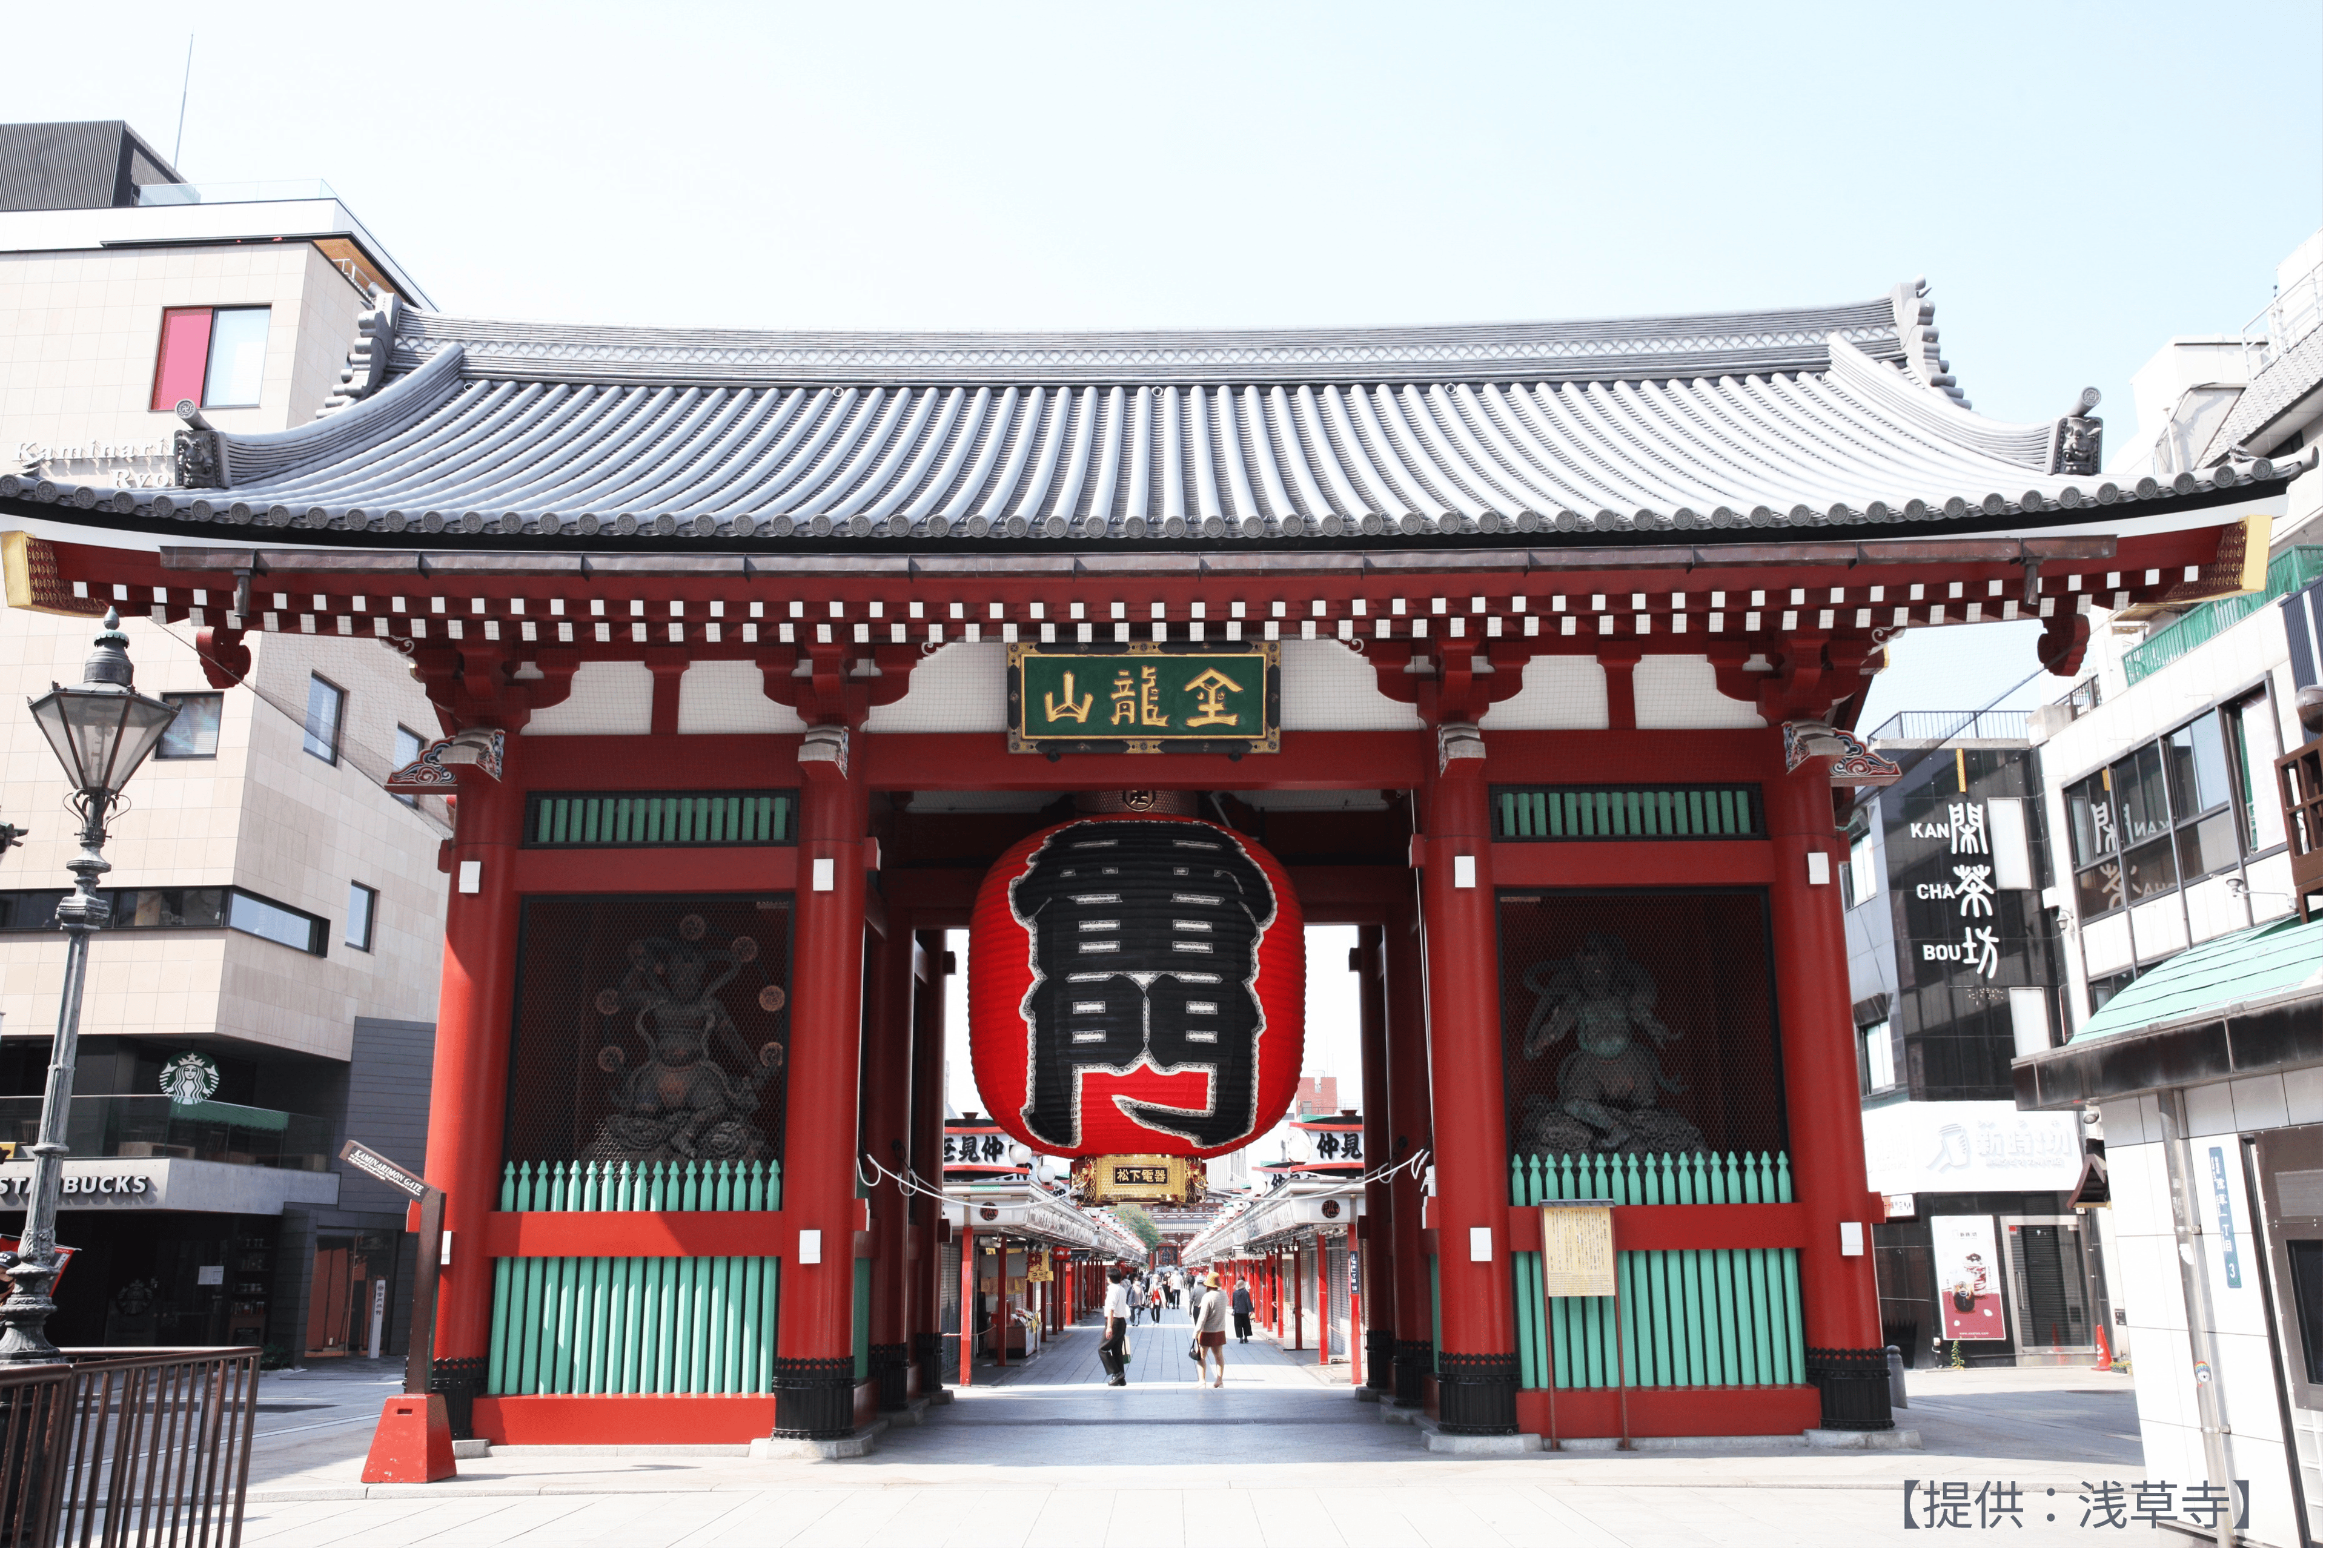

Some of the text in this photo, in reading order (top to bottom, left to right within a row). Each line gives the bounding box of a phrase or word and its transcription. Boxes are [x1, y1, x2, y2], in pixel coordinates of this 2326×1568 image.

[111, 468, 175, 488] Ryo
[1910, 822, 1950, 838] KAN
[1916, 883, 1955, 899] CHA
[1923, 944, 1961, 961] BOU
[1007, 819, 1279, 1149] 雷門
[354, 1150, 405, 1182] KAMINARIMON
[403, 1178, 424, 1193] GATE
[1117, 1168, 1166, 1182] 松下電器
[0, 1176, 147, 1194] STBUCKS
[2229, 1263, 2236, 1278] 3
